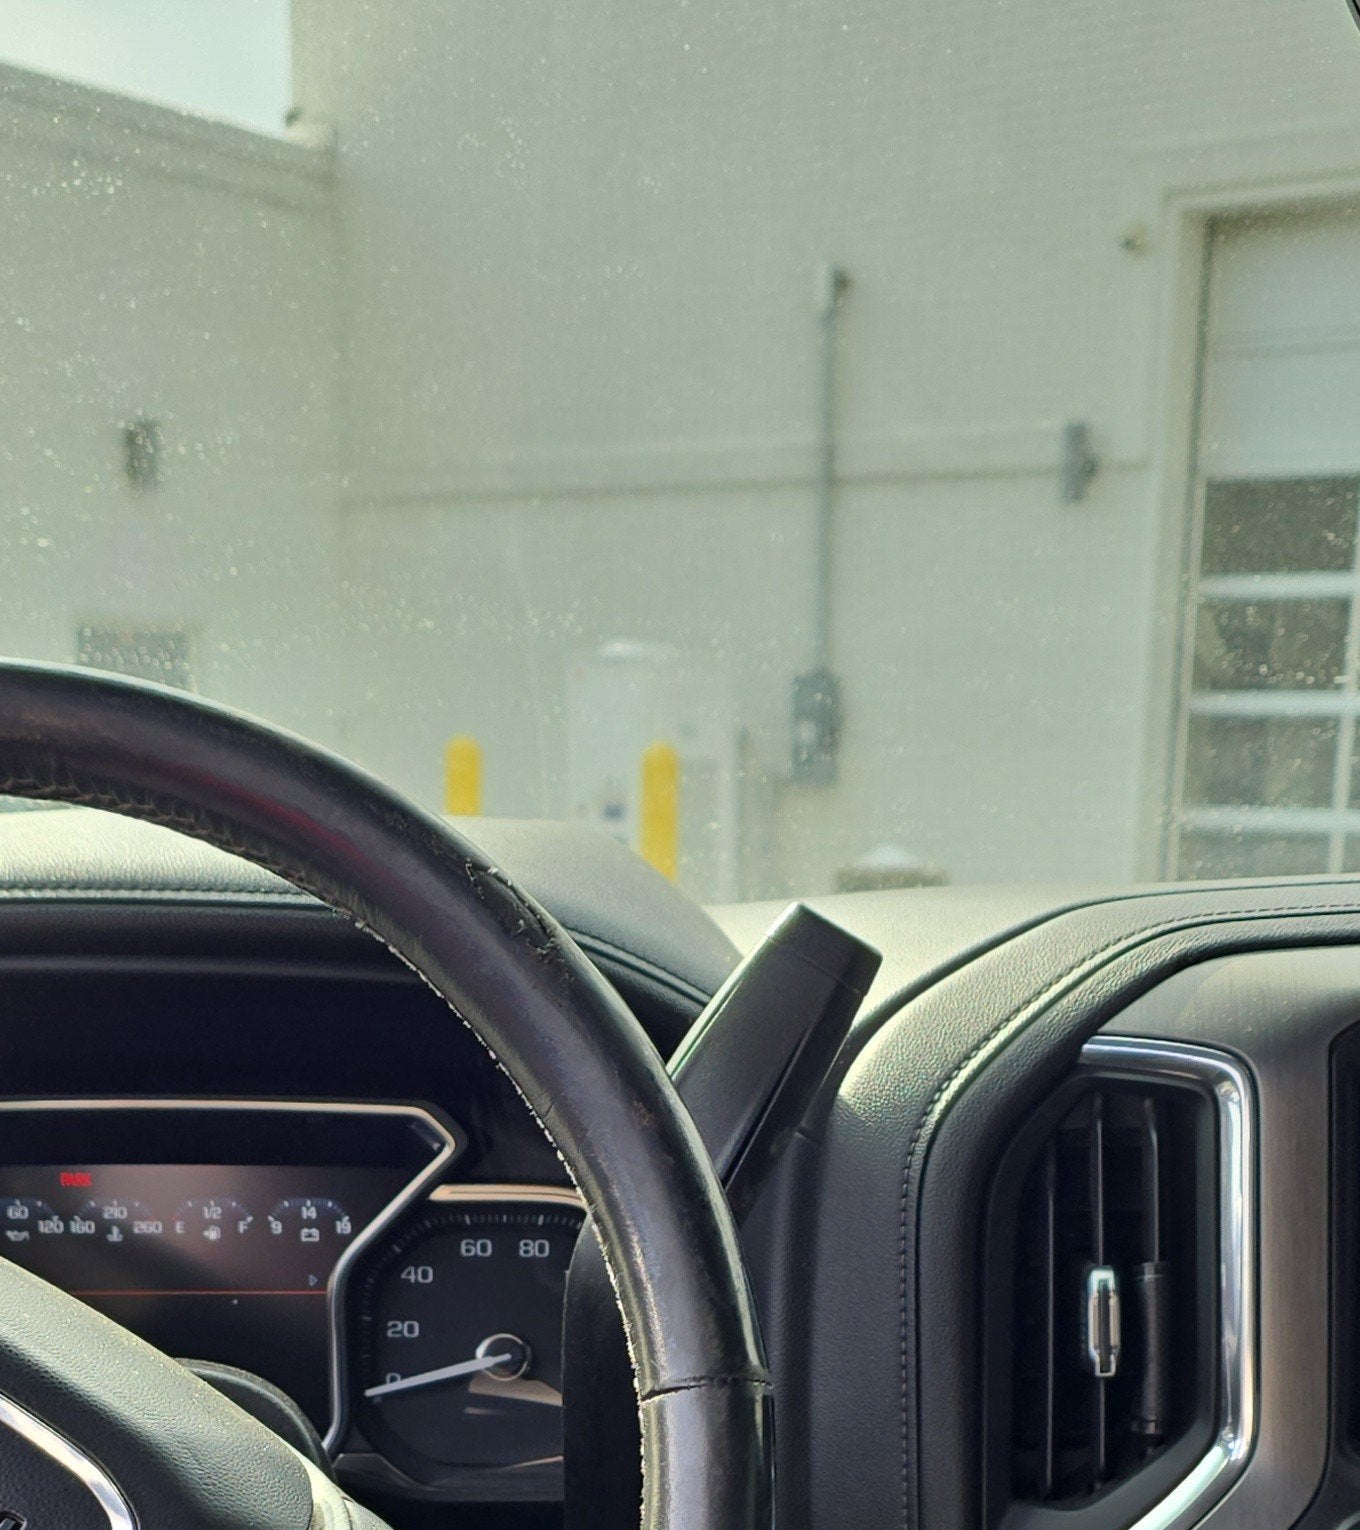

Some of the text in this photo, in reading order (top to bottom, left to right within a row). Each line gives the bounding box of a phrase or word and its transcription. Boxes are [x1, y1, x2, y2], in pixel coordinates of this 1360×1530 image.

[60, 1172, 92, 1187] PARK
[6, 1206, 29, 1219] 60
[102, 1206, 127, 1219] 210
[203, 1206, 222, 1219] 1/2
[301, 1206, 317, 1219] 14
[38, 1221, 64, 1234] 120
[70, 1221, 95, 1234] 160
[133, 1221, 162, 1234] 260
[176, 1221, 185, 1234] E
[239, 1221, 249, 1234] F
[271, 1221, 282, 1234] 9
[335, 1221, 351, 1234] 19
[460, 1239, 492, 1257] 60
[519, 1239, 549, 1257] 80
[401, 1266, 434, 1283] 40
[387, 1321, 419, 1338] 20
